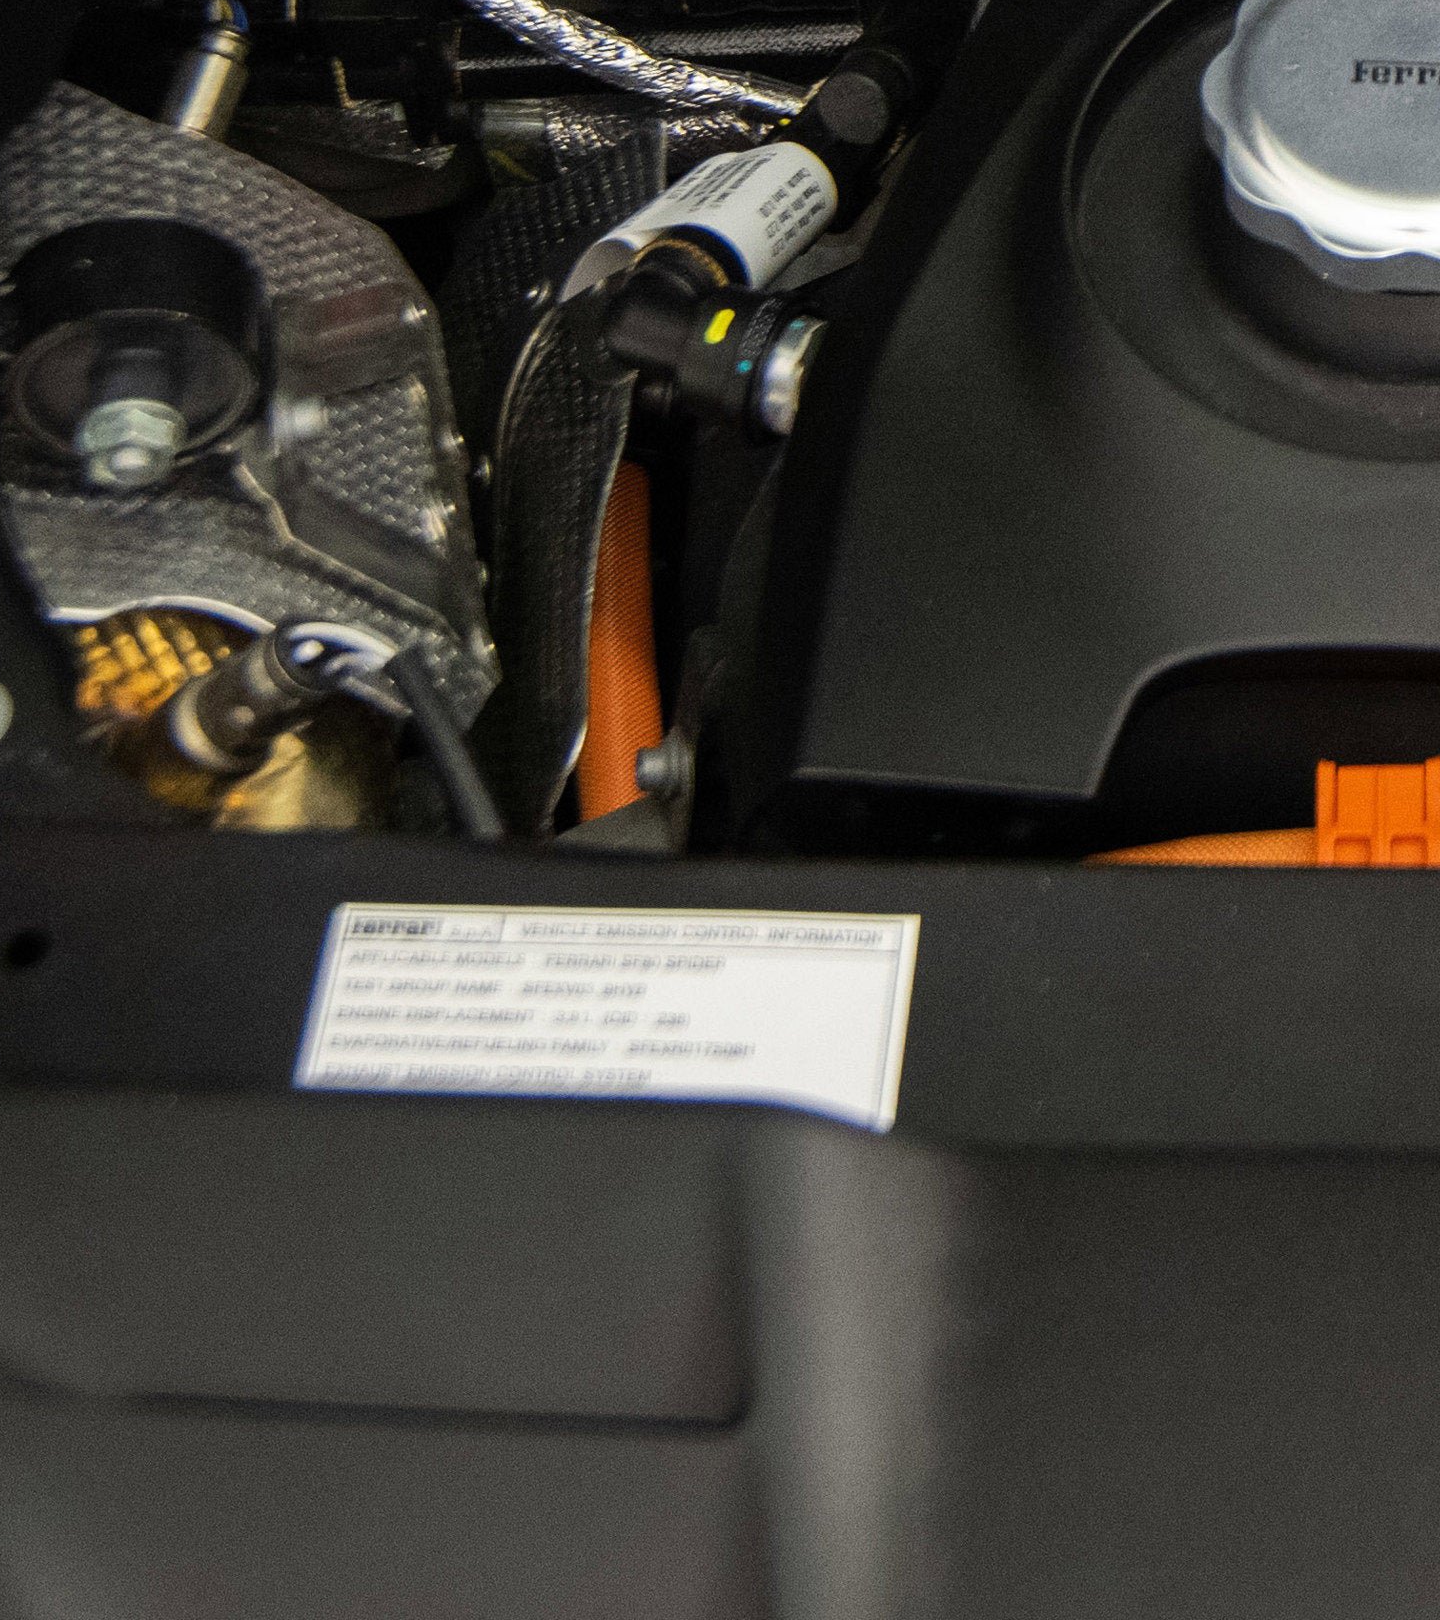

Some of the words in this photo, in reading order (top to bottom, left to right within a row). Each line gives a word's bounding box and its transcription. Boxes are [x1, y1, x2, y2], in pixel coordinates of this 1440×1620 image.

[520, 920, 589, 937] VEHICLE
[595, 923, 677, 940] EMISSION
[682, 924, 760, 941] CONTROL
[767, 926, 883, 945] INFORMATION
